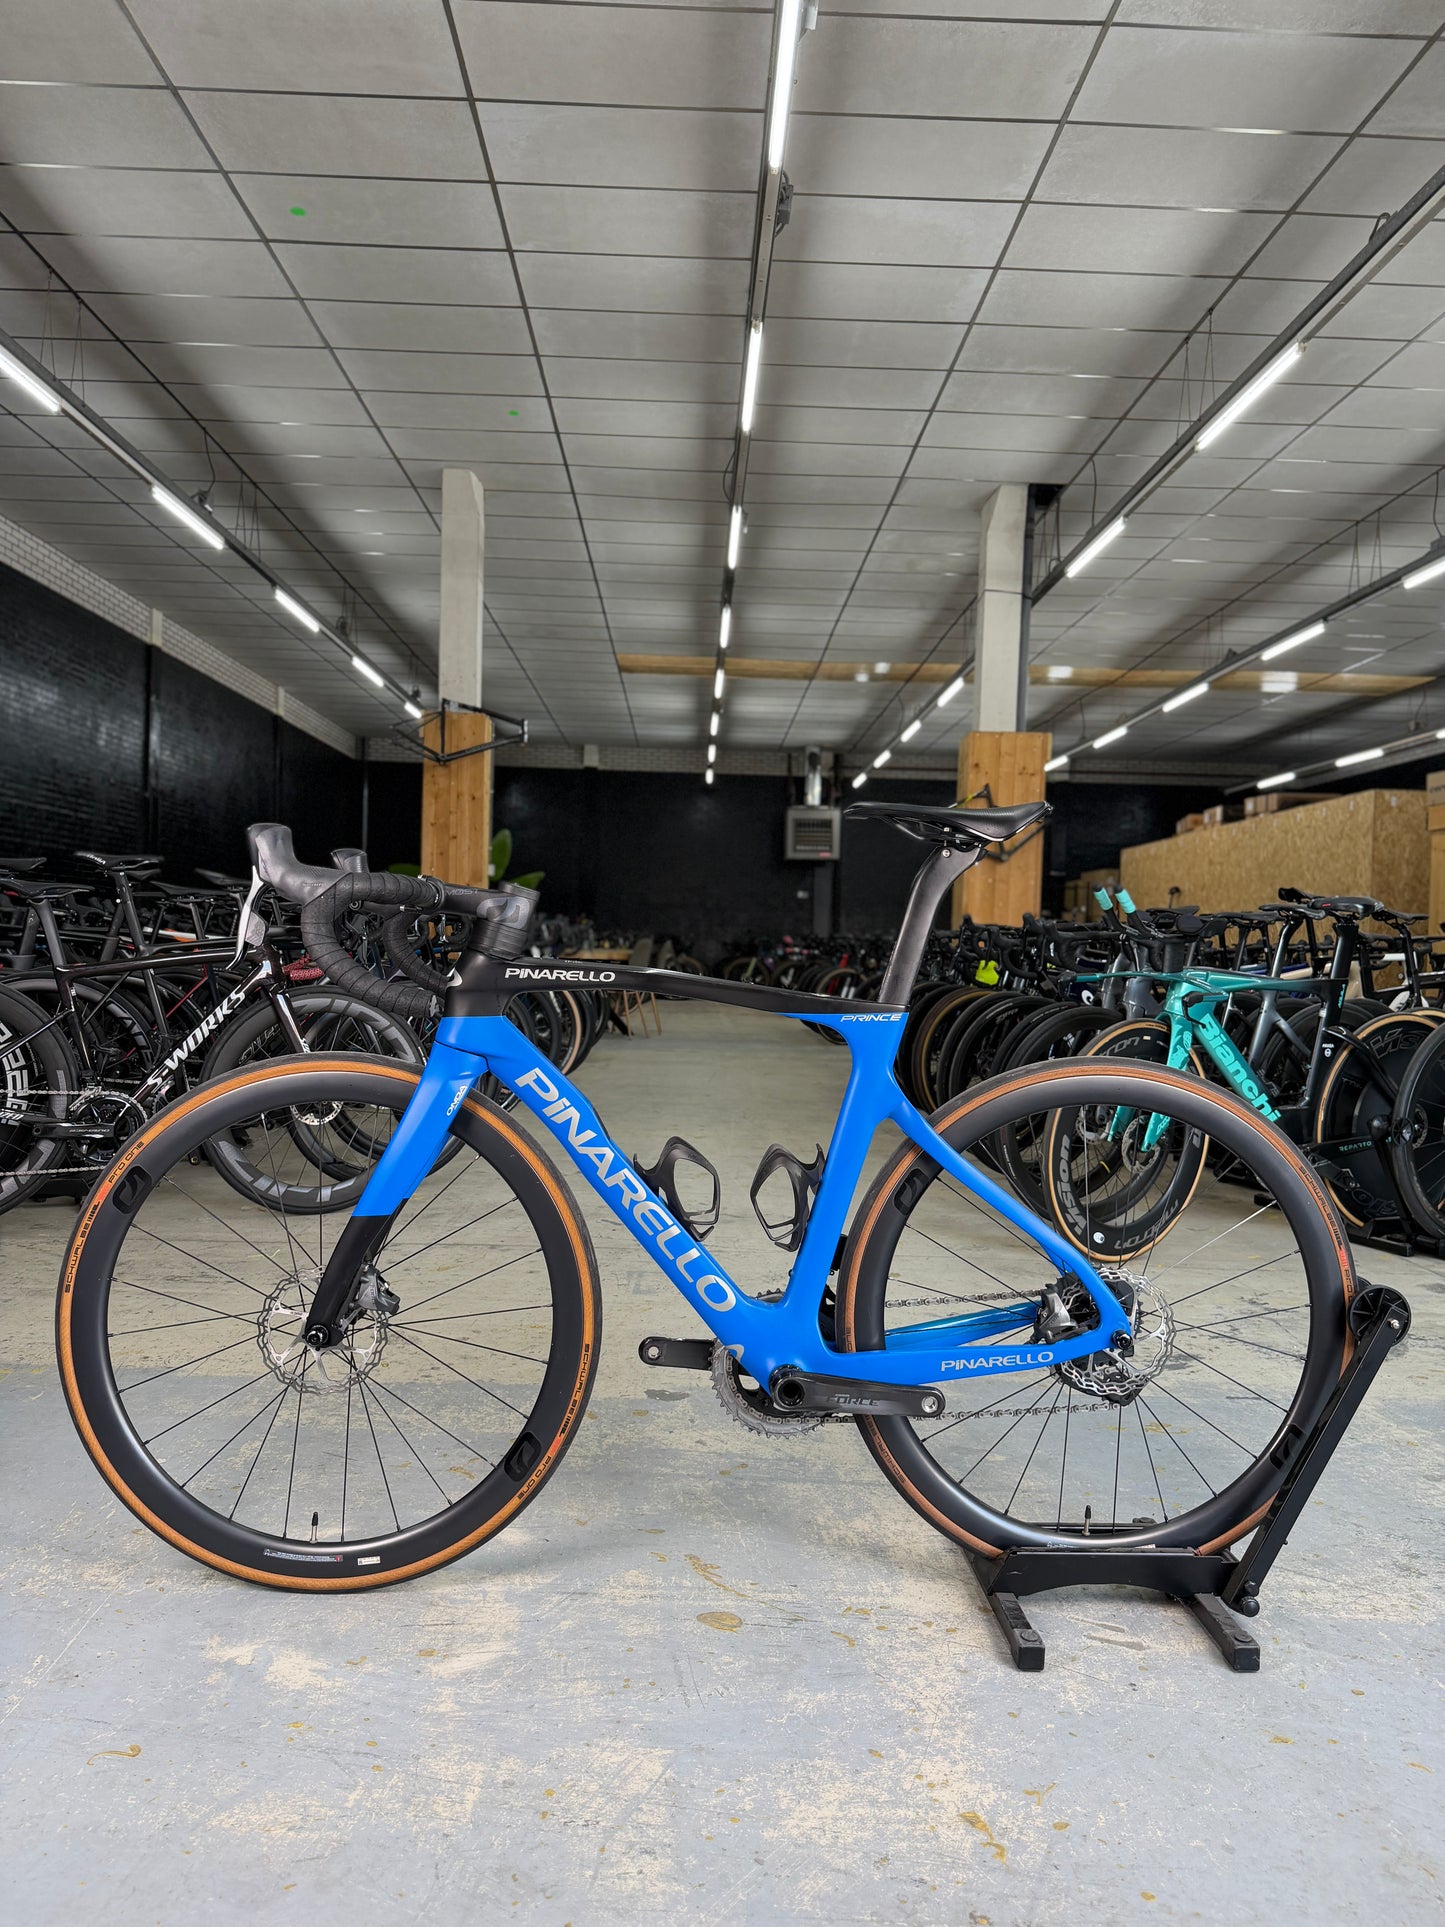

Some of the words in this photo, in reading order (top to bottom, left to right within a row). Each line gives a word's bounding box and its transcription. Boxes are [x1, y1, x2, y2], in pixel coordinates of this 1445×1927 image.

[505, 968, 616, 982] PINARELLO
[146, 984, 246, 1094] S-WORKS
[840, 1013, 902, 1023] PRINCE
[1199, 1013, 1282, 1122] Bianchi
[446, 1085, 468, 1117] ONDA
[515, 1067, 737, 1313] PINARELLO
[64, 1221, 91, 1294] SCHWALBE
[568, 1343, 590, 1416] SCHWALBE
[940, 1351, 1054, 1372] PINARELLO
[828, 1395, 880, 1407] FORCE
